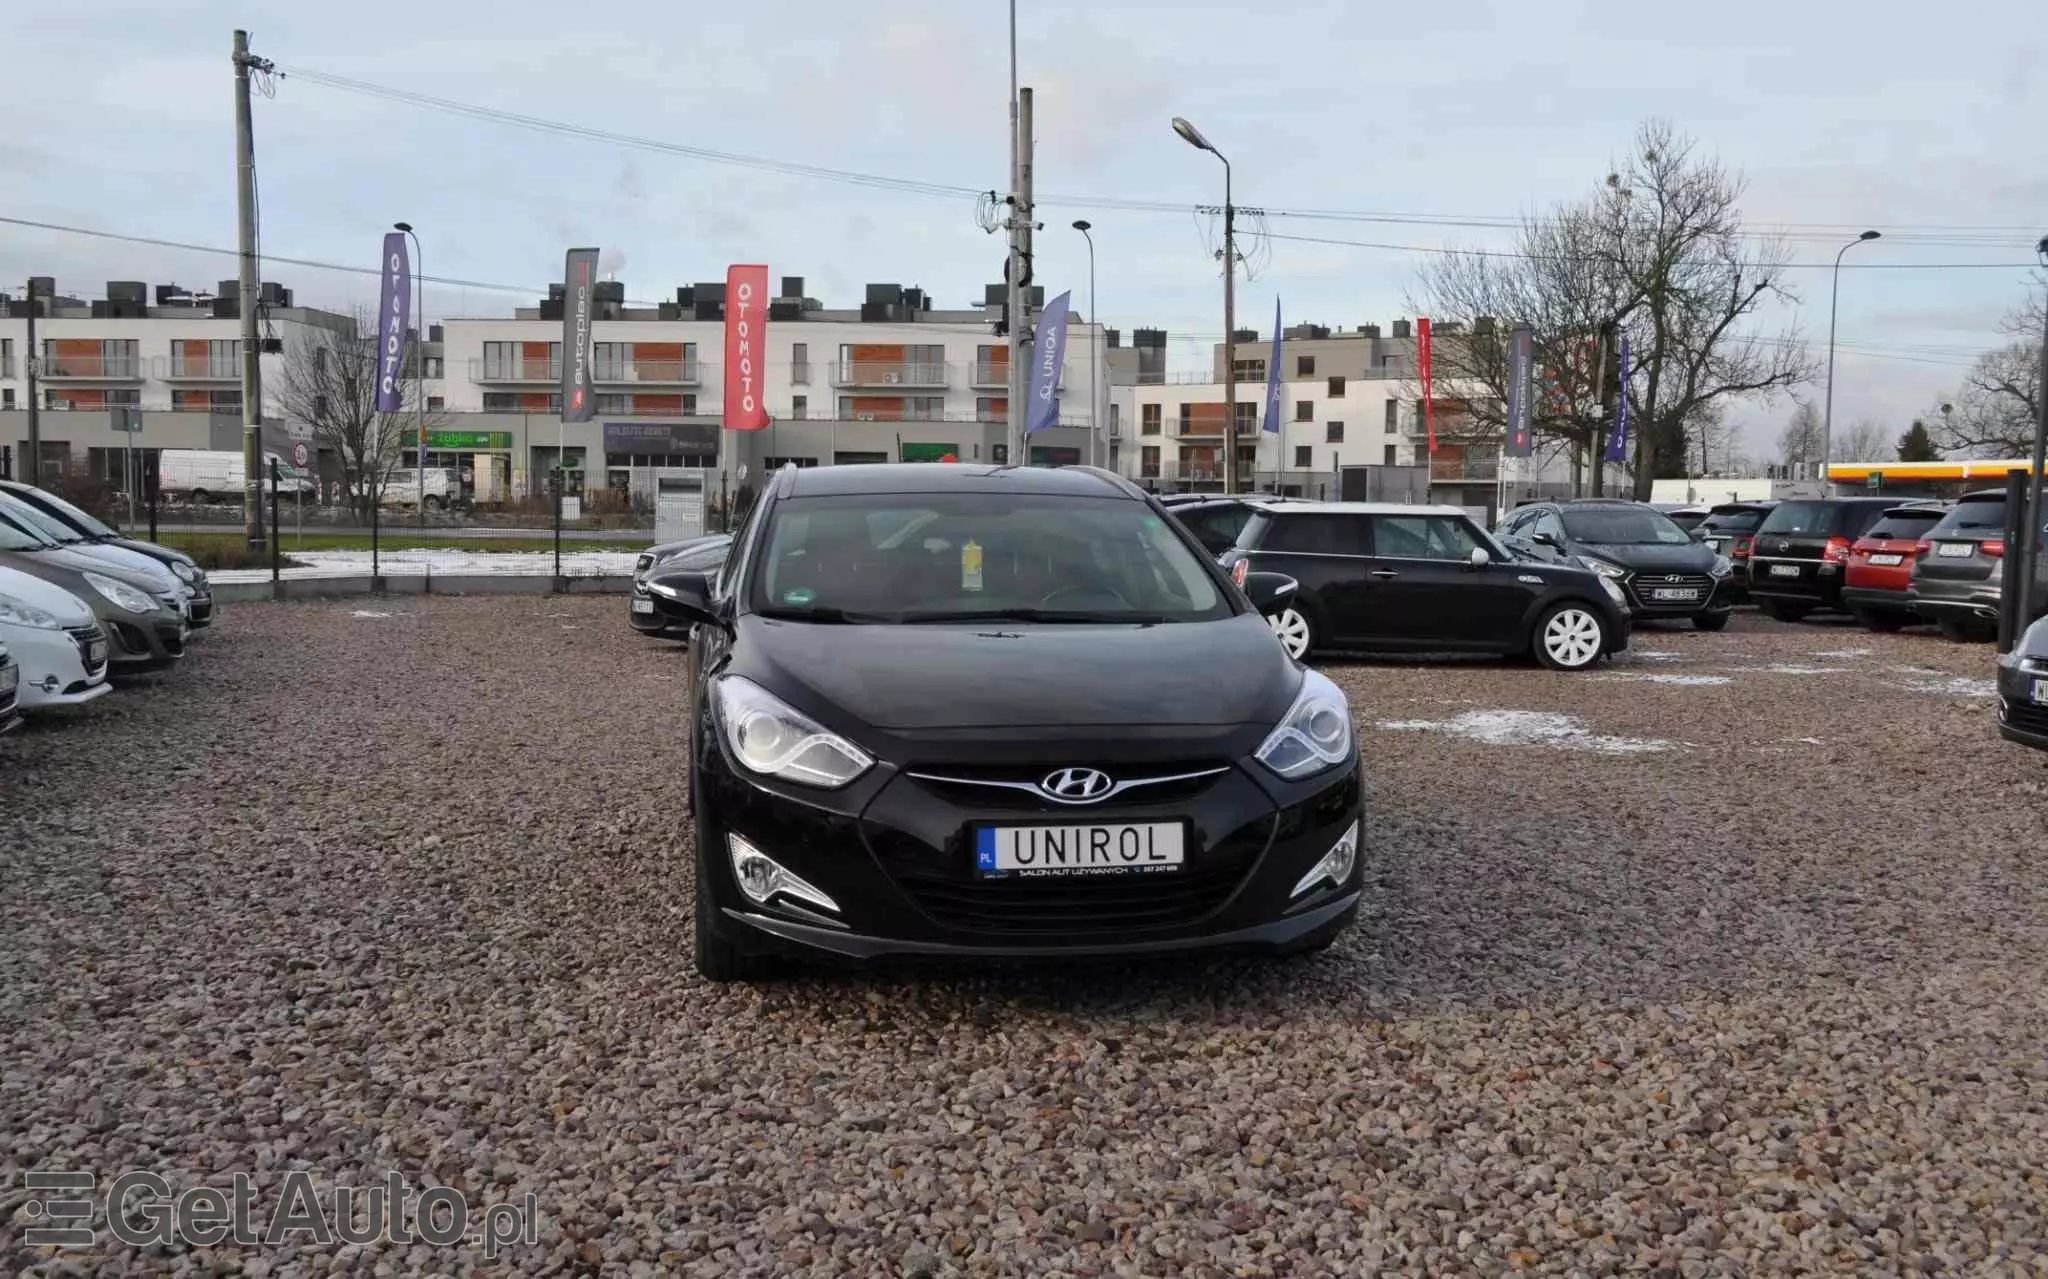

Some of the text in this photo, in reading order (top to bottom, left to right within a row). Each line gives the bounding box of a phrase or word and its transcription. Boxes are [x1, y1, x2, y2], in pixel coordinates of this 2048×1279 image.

[737, 282, 755, 413] OTOMOTO
[1043, 325, 1058, 377] UNIQA
[980, 826, 1166, 864] PL UNIROL
